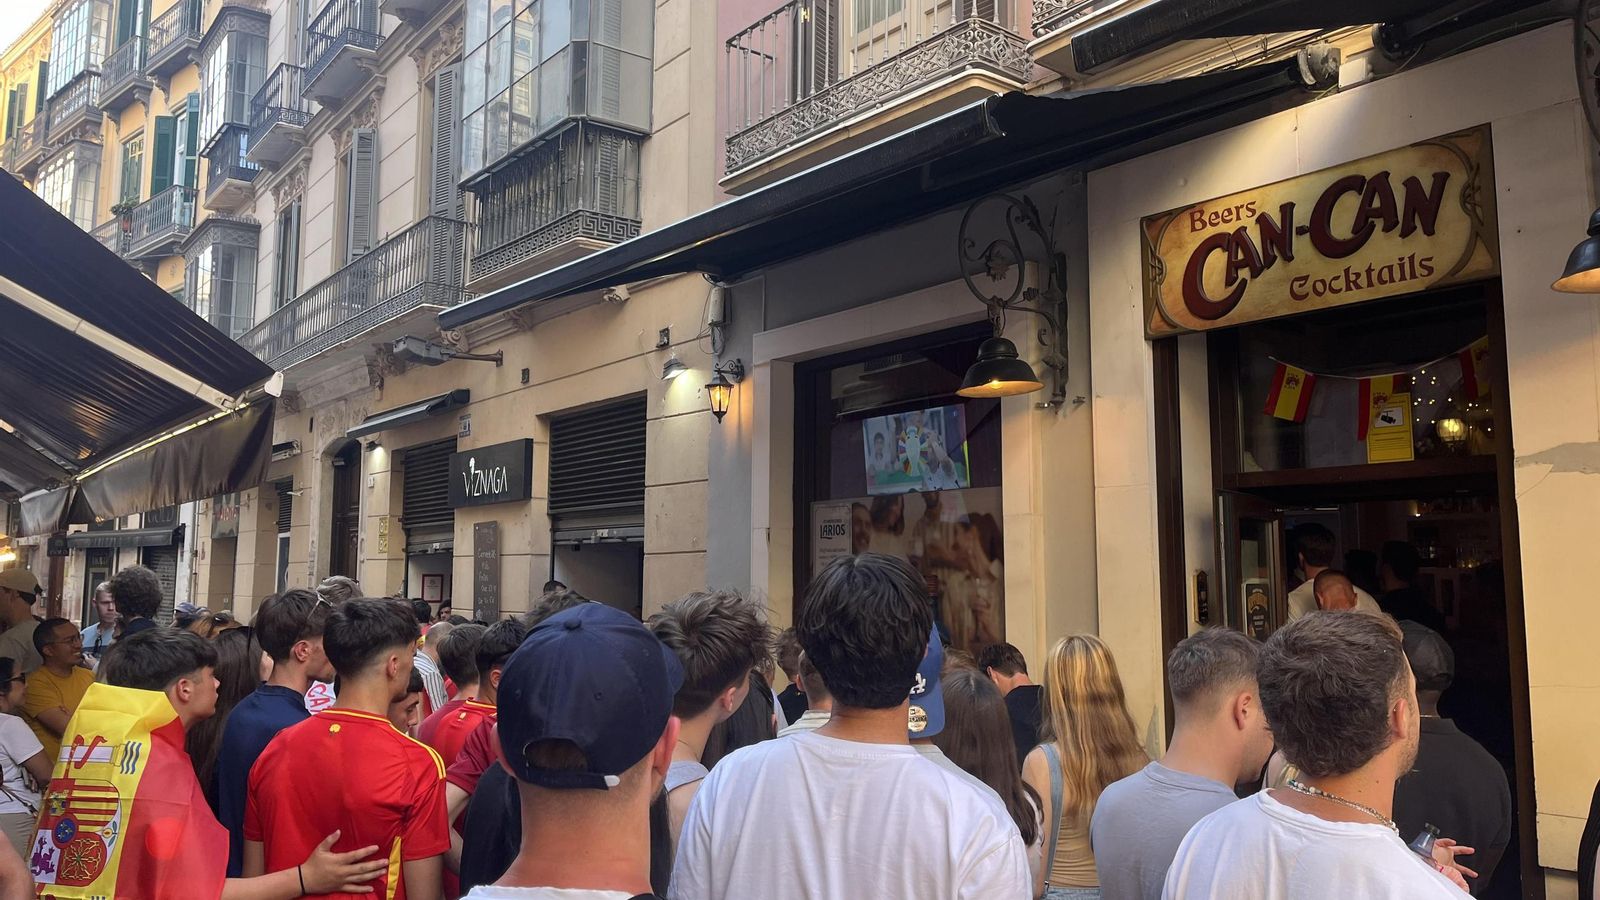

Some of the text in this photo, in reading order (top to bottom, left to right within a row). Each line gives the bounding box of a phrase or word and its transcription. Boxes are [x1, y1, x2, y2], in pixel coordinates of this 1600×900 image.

[1189, 200, 1258, 234] Beers
[1182, 171, 1450, 321] CAN-CAN
[1289, 252, 1435, 301] Cocktails
[462, 457, 508, 497] VIZNAGA
[820, 523, 846, 540] LARIOS
[307, 683, 333, 713] CA
